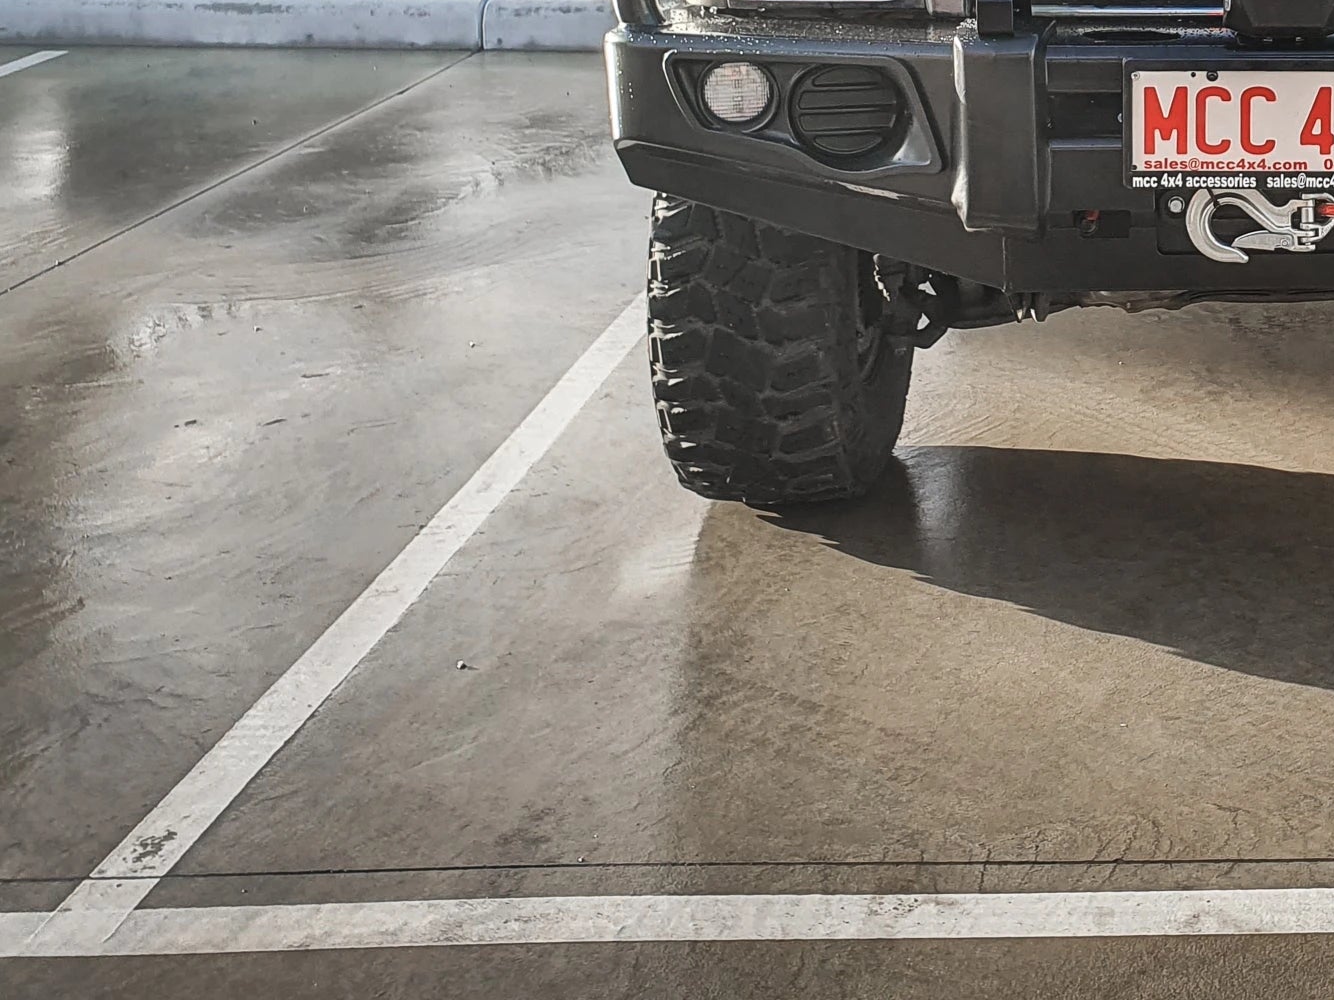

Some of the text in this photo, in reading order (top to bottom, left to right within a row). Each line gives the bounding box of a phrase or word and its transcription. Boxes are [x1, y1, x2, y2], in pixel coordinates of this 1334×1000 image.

[1143, 85, 1277, 155] MCC
[1144, 157, 1308, 171] sales@mcc4x4.com
[1132, 175, 1158, 188] mcc
[1160, 172, 1183, 188] 4x4
[1185, 173, 1257, 188] accessories
